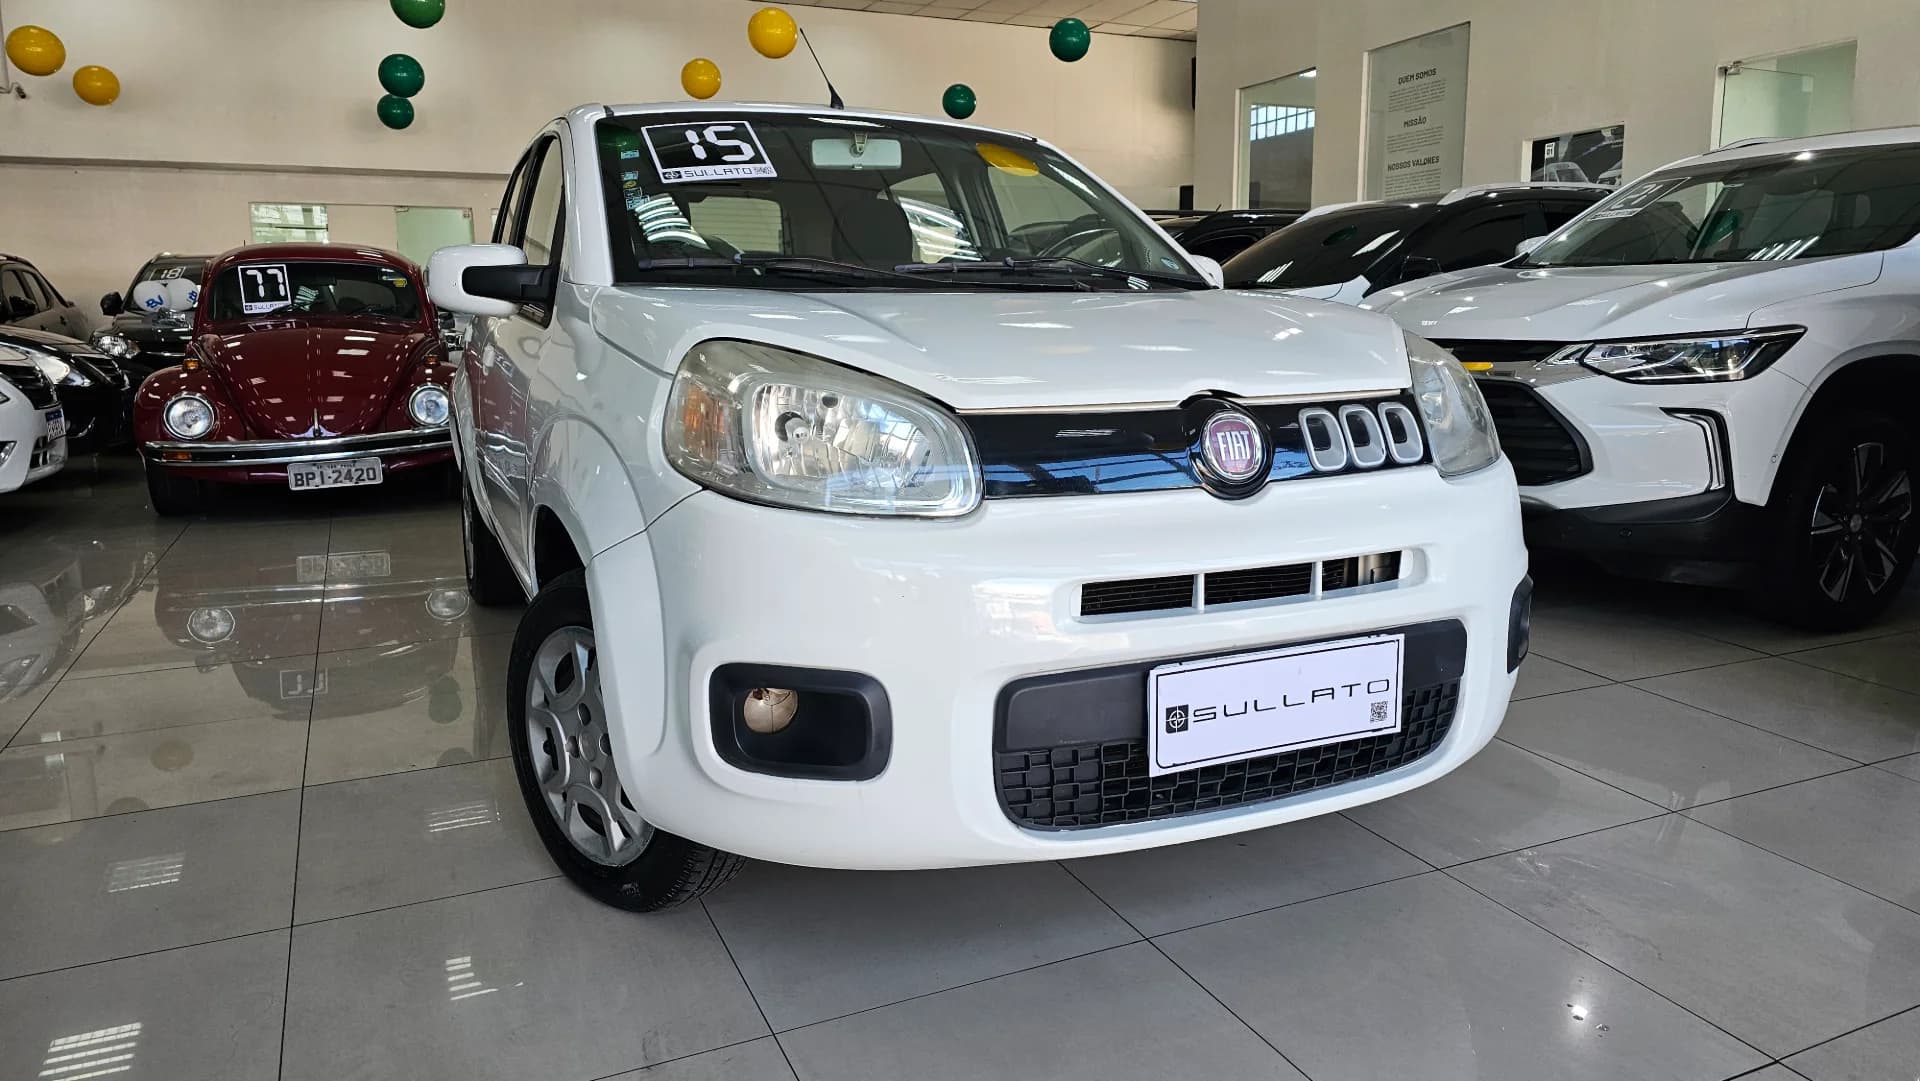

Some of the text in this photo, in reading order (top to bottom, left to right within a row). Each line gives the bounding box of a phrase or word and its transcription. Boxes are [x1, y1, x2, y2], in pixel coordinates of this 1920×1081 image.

[1398, 67, 1437, 85] QUEM SOMOS
[1403, 115, 1428, 128] MISSÃO
[685, 125, 756, 162] 15
[683, 167, 752, 178] SULLATO
[1387, 155, 1440, 172] NOSSOS VALORES
[246, 268, 286, 298] 77
[1216, 430, 1251, 461] FIAT
[1192, 678, 1390, 723] SULLATO
